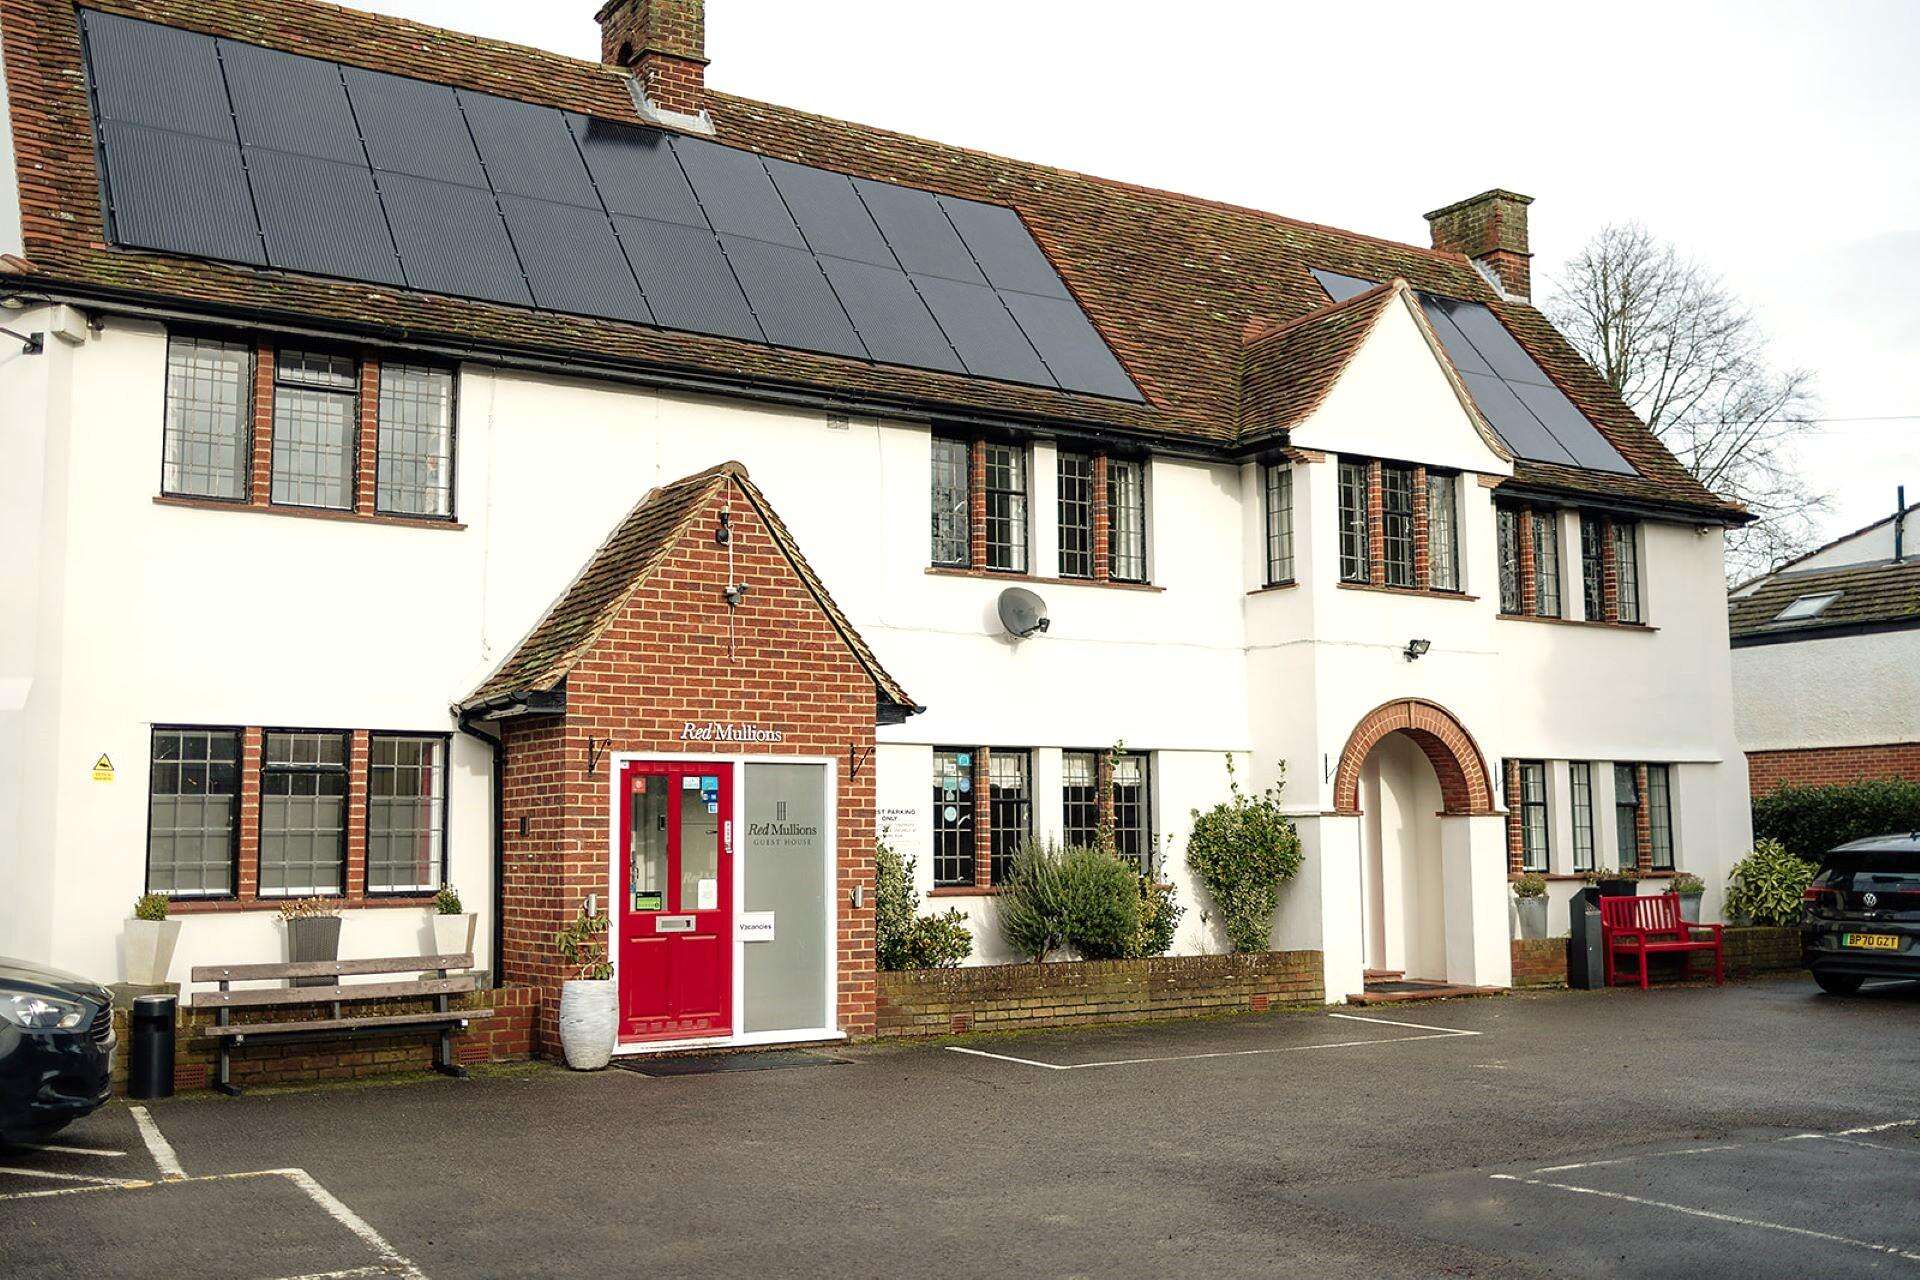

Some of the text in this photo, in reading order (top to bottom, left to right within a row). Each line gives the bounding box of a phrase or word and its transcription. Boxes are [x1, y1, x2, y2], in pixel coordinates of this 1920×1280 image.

[680, 721, 782, 742] Red Mullions
[748, 823, 818, 836] Red Mullions
[740, 922, 772, 930] Vacancies
[1849, 934, 1897, 947] BP70 GZT
